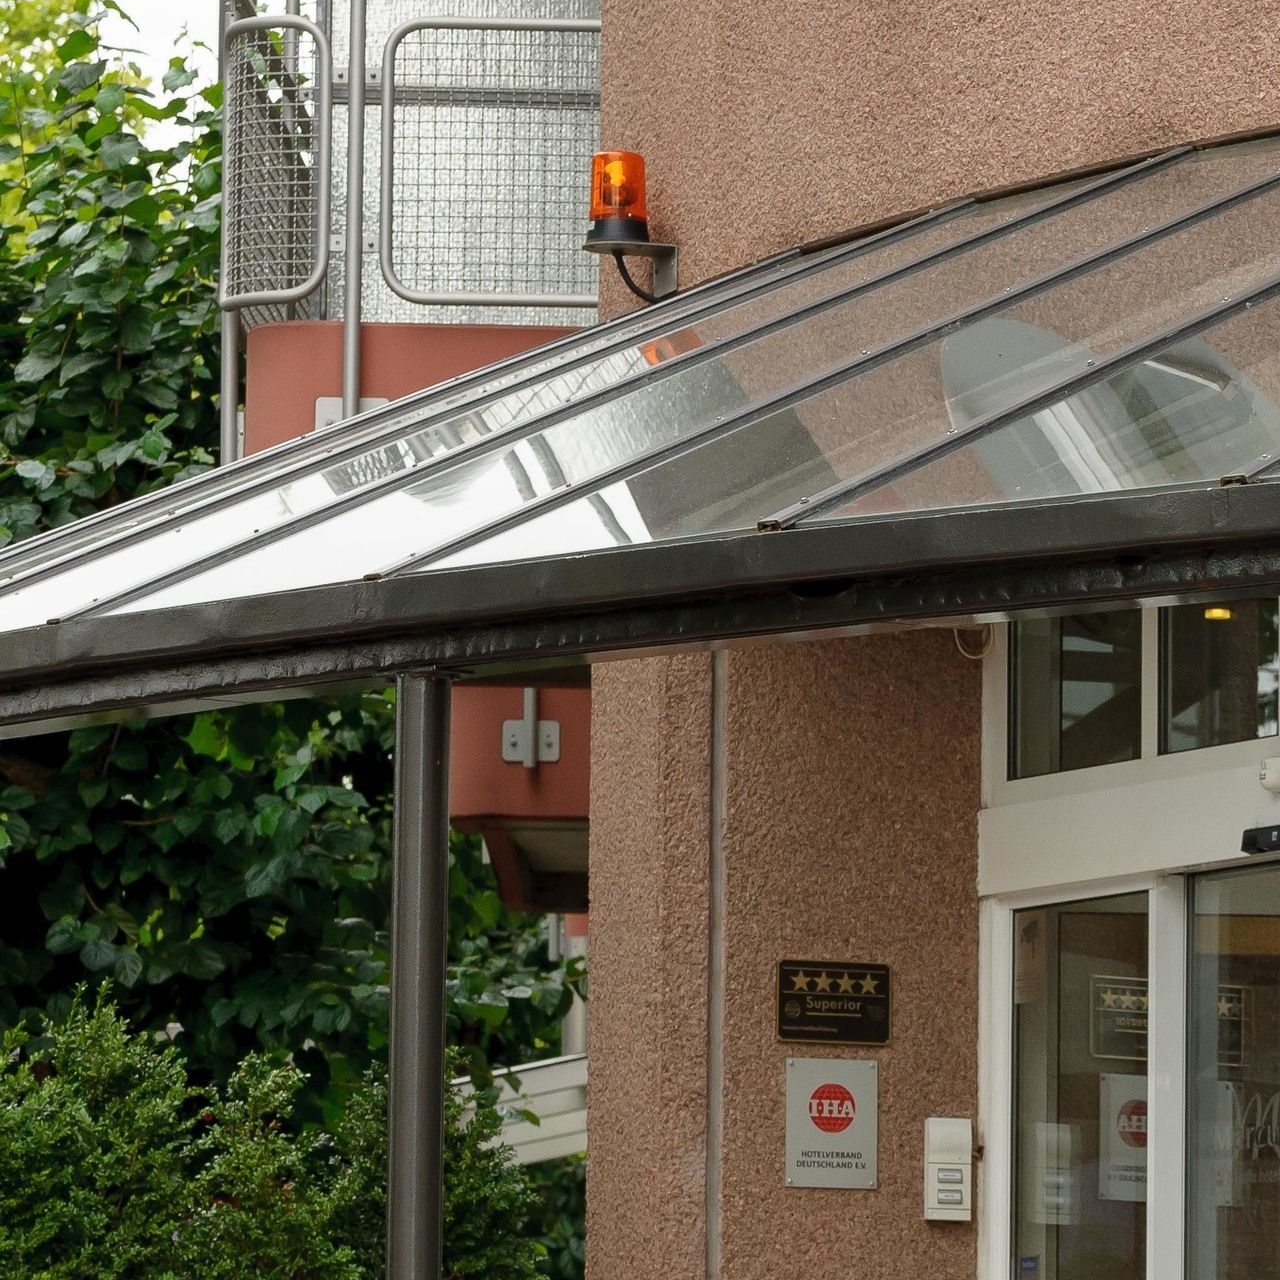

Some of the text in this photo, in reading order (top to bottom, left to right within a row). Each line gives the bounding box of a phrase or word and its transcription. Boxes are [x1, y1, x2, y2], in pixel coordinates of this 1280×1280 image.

[806, 996, 862, 1012] Superior
[801, 1150, 863, 1160] HOTELVERBAND
[796, 1160, 853, 1169] DEUTSCHLAND
